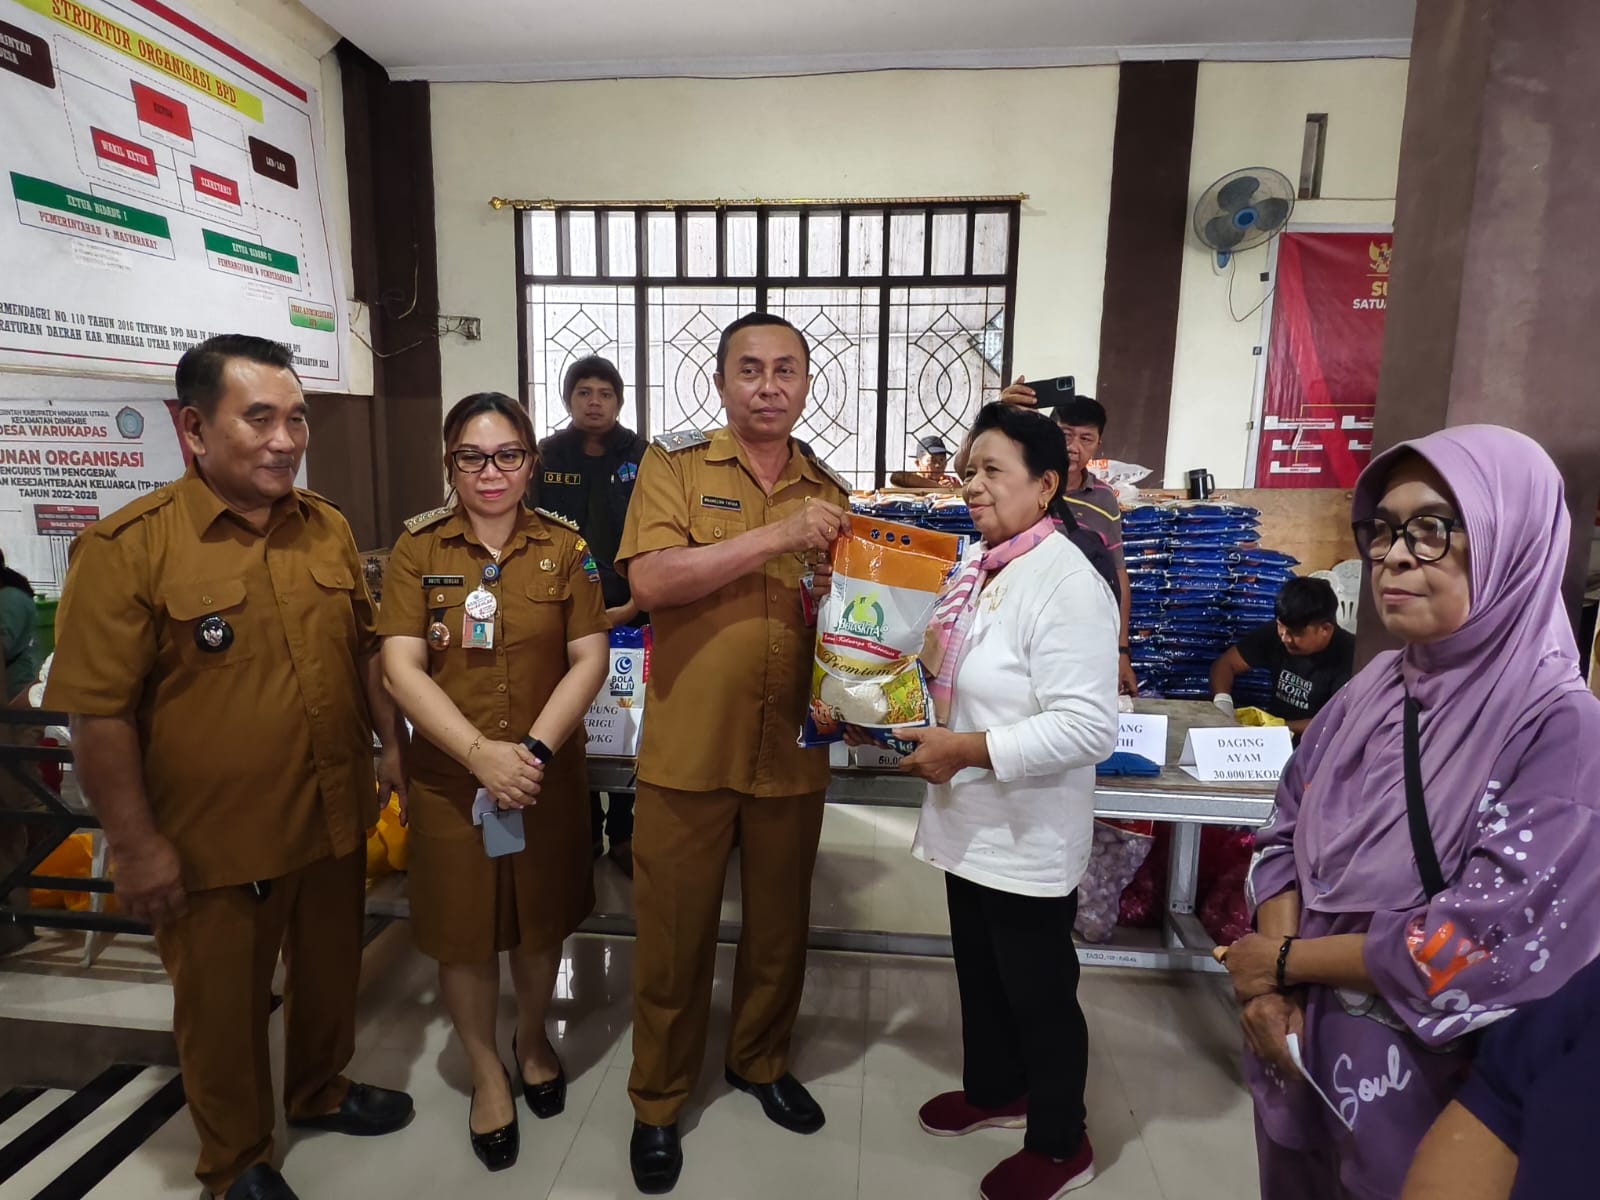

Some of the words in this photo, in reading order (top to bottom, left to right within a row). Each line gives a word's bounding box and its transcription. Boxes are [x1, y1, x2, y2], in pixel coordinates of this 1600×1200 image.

[51, 0, 132, 51] STRUKTUR
[138, 39, 212, 91] ORGANISASI
[215, 79, 237, 103] BPD
[1352, 298, 1387, 309] SATU
[71, 313, 85, 325] 110
[87, 315, 115, 329] TAHUN
[118, 319, 134, 332] 2016
[136, 322, 168, 336] TENTANG
[170, 326, 184, 338] BPD
[46, 325, 82, 341] DAERAH
[106, 332, 145, 348] MINAHASA
[147, 337, 171, 351] UTARA
[22, 408, 57, 417] KABUPATEN
[11, 416, 54, 425] KECAMATAN
[54, 417, 87, 425] DIMEMBE
[29, 425, 108, 438] WARUKAPAS
[45, 449, 144, 468] ORGANISASI
[43, 467, 60, 477] TIM
[61, 468, 117, 478] PENGGERAK
[11, 477, 88, 490] KESEJAHTERAAN
[89, 479, 136, 490] KELUARGA
[19, 488, 50, 498] TAHUN
[51, 490, 97, 500] 2022-2028
[611, 675, 634, 683] BOLA
[609, 682, 635, 691] SALJU
[887, 739, 897, 750] 5
[1217, 737, 1264, 749] DAGING
[1226, 752, 1261, 763] AYAM
[1212, 769, 1280, 780] 30.000/EKOR
[1332, 1043, 1412, 1131] Soul
